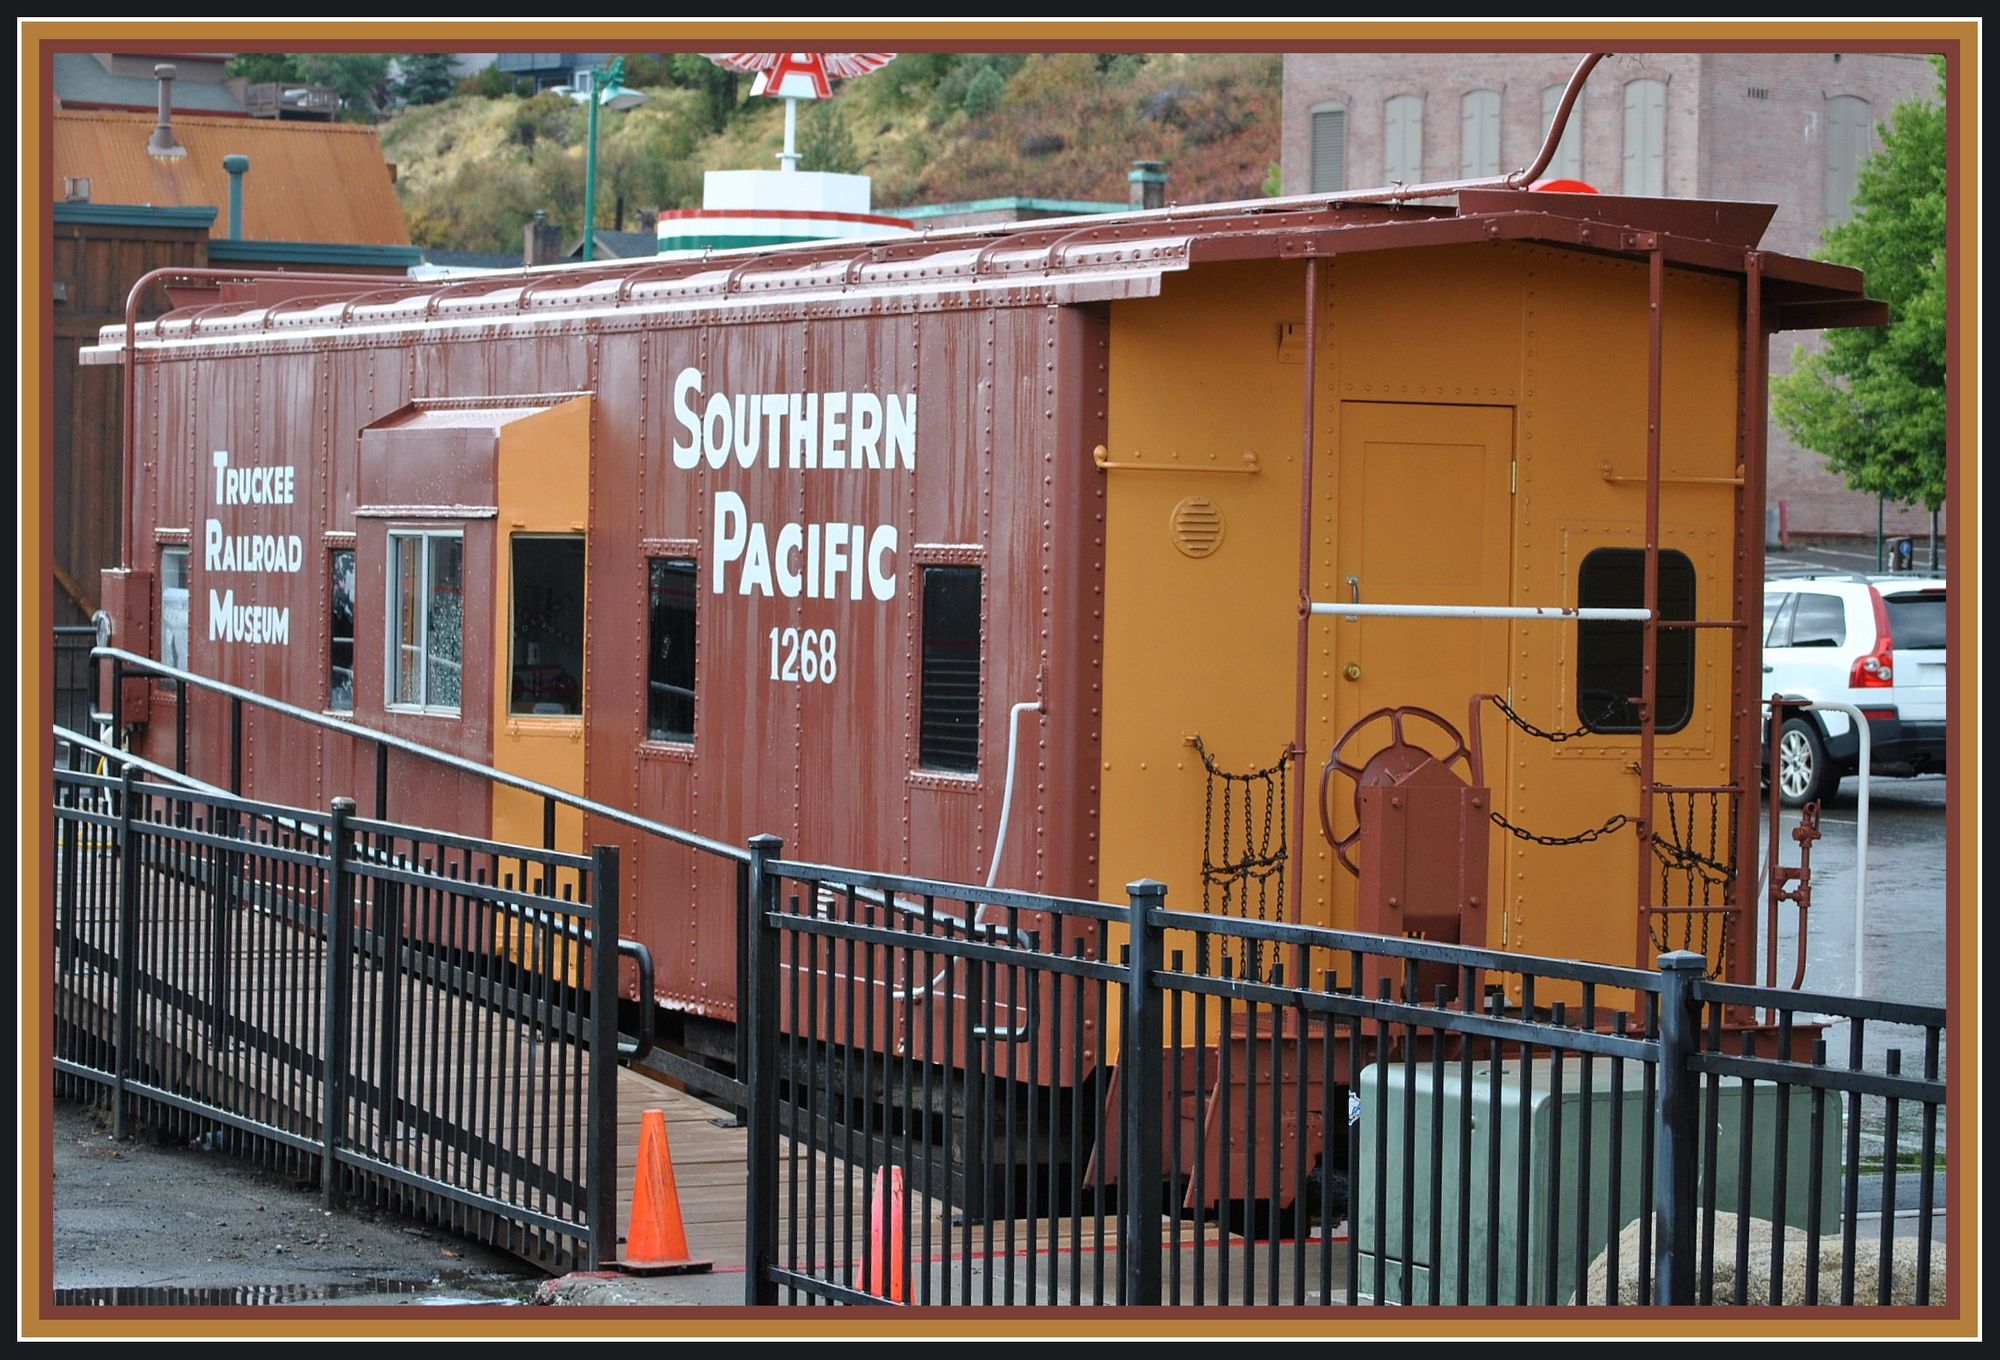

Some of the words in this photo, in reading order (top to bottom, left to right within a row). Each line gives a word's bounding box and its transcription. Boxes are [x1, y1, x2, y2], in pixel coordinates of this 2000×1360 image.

[673, 367, 917, 470] SOUTHERN
[213, 451, 295, 505] TRUCKEE
[205, 518, 303, 573] RAILROAD
[712, 491, 898, 601] PACIFIC
[209, 589, 290, 645] MUSEUM
[769, 627, 837, 684] 1268
